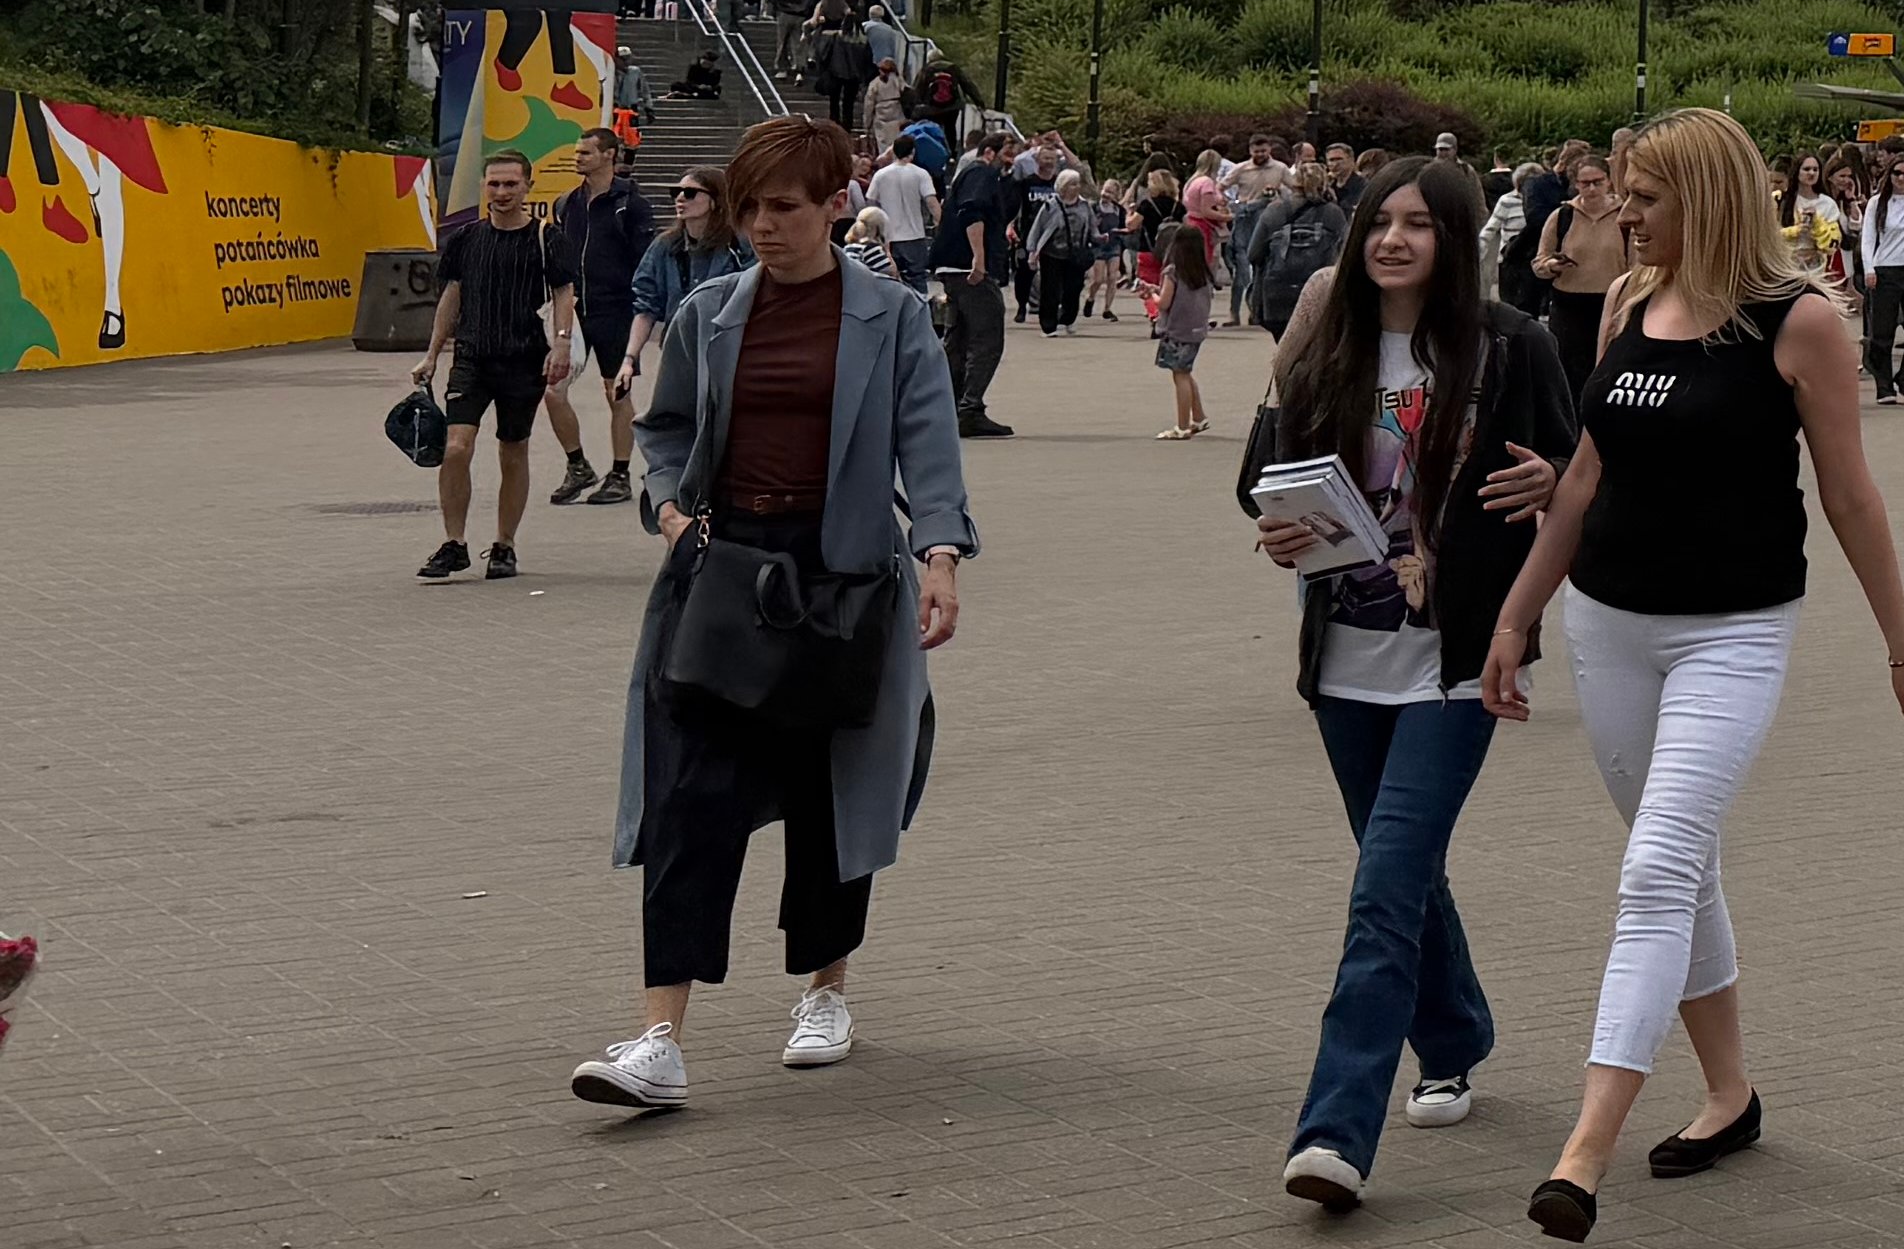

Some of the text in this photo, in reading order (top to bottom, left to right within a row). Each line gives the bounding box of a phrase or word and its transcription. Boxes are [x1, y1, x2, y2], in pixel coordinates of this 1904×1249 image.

[205, 190, 280, 223] koncerty
[214, 231, 320, 270] potańcówka
[221, 274, 351, 313] pokazy filmowe
